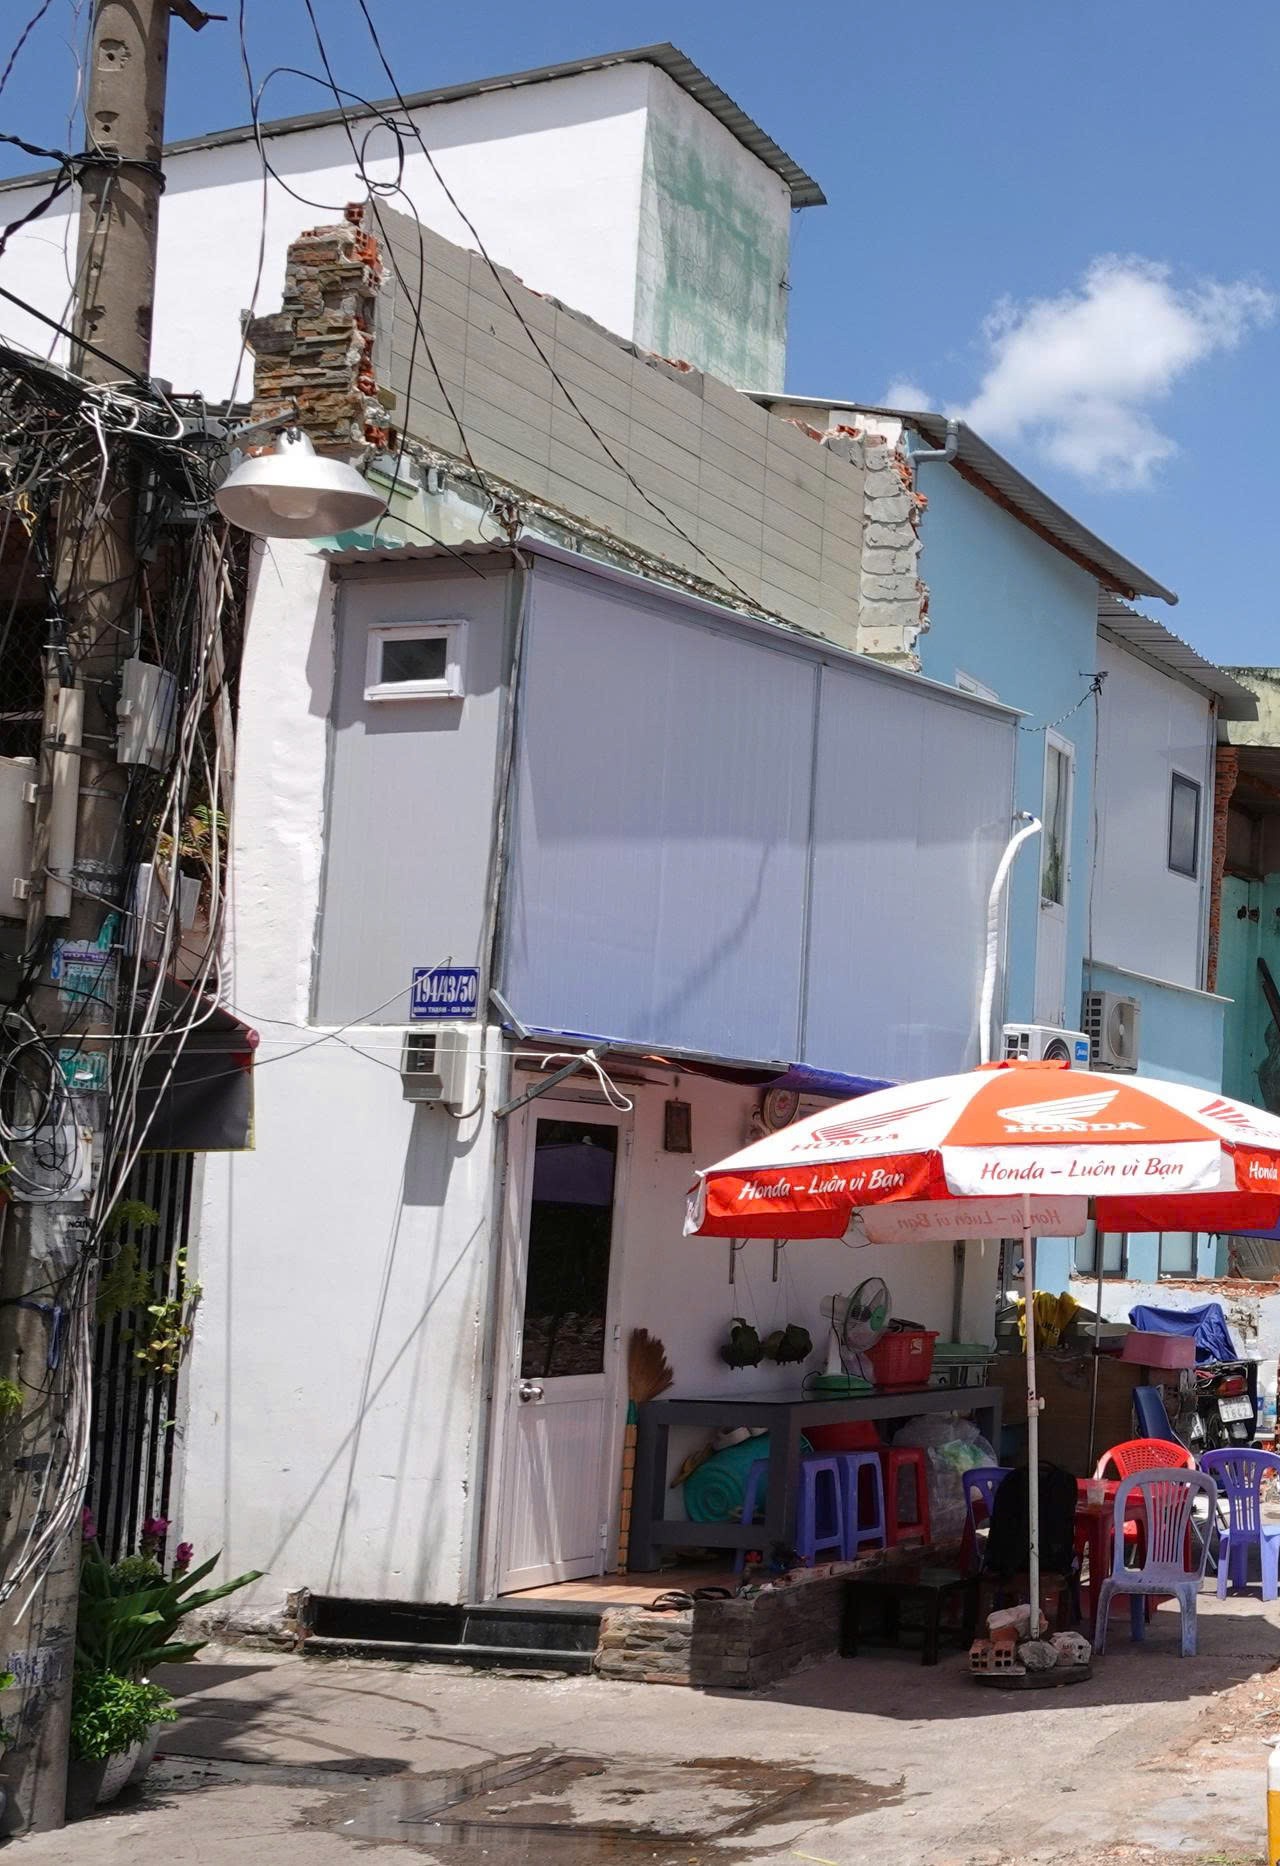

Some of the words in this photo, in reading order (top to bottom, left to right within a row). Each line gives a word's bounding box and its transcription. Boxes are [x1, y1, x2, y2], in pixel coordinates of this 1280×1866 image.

[414, 975, 477, 1003] 194/43/50
[1003, 1122, 1146, 1133] HONDA
[791, 1133, 899, 1151] HONDA
[980, 1161, 1045, 1181] Honda
[1068, 1160, 1115, 1178] Luôn
[1122, 1159, 1139, 1176] vì
[1144, 1157, 1184, 1180] Bạn
[738, 1177, 790, 1200] Honda
[808, 1175, 846, 1194] Luôn
[850, 1171, 867, 1191] vì
[868, 1168, 905, 1192] Bạn
